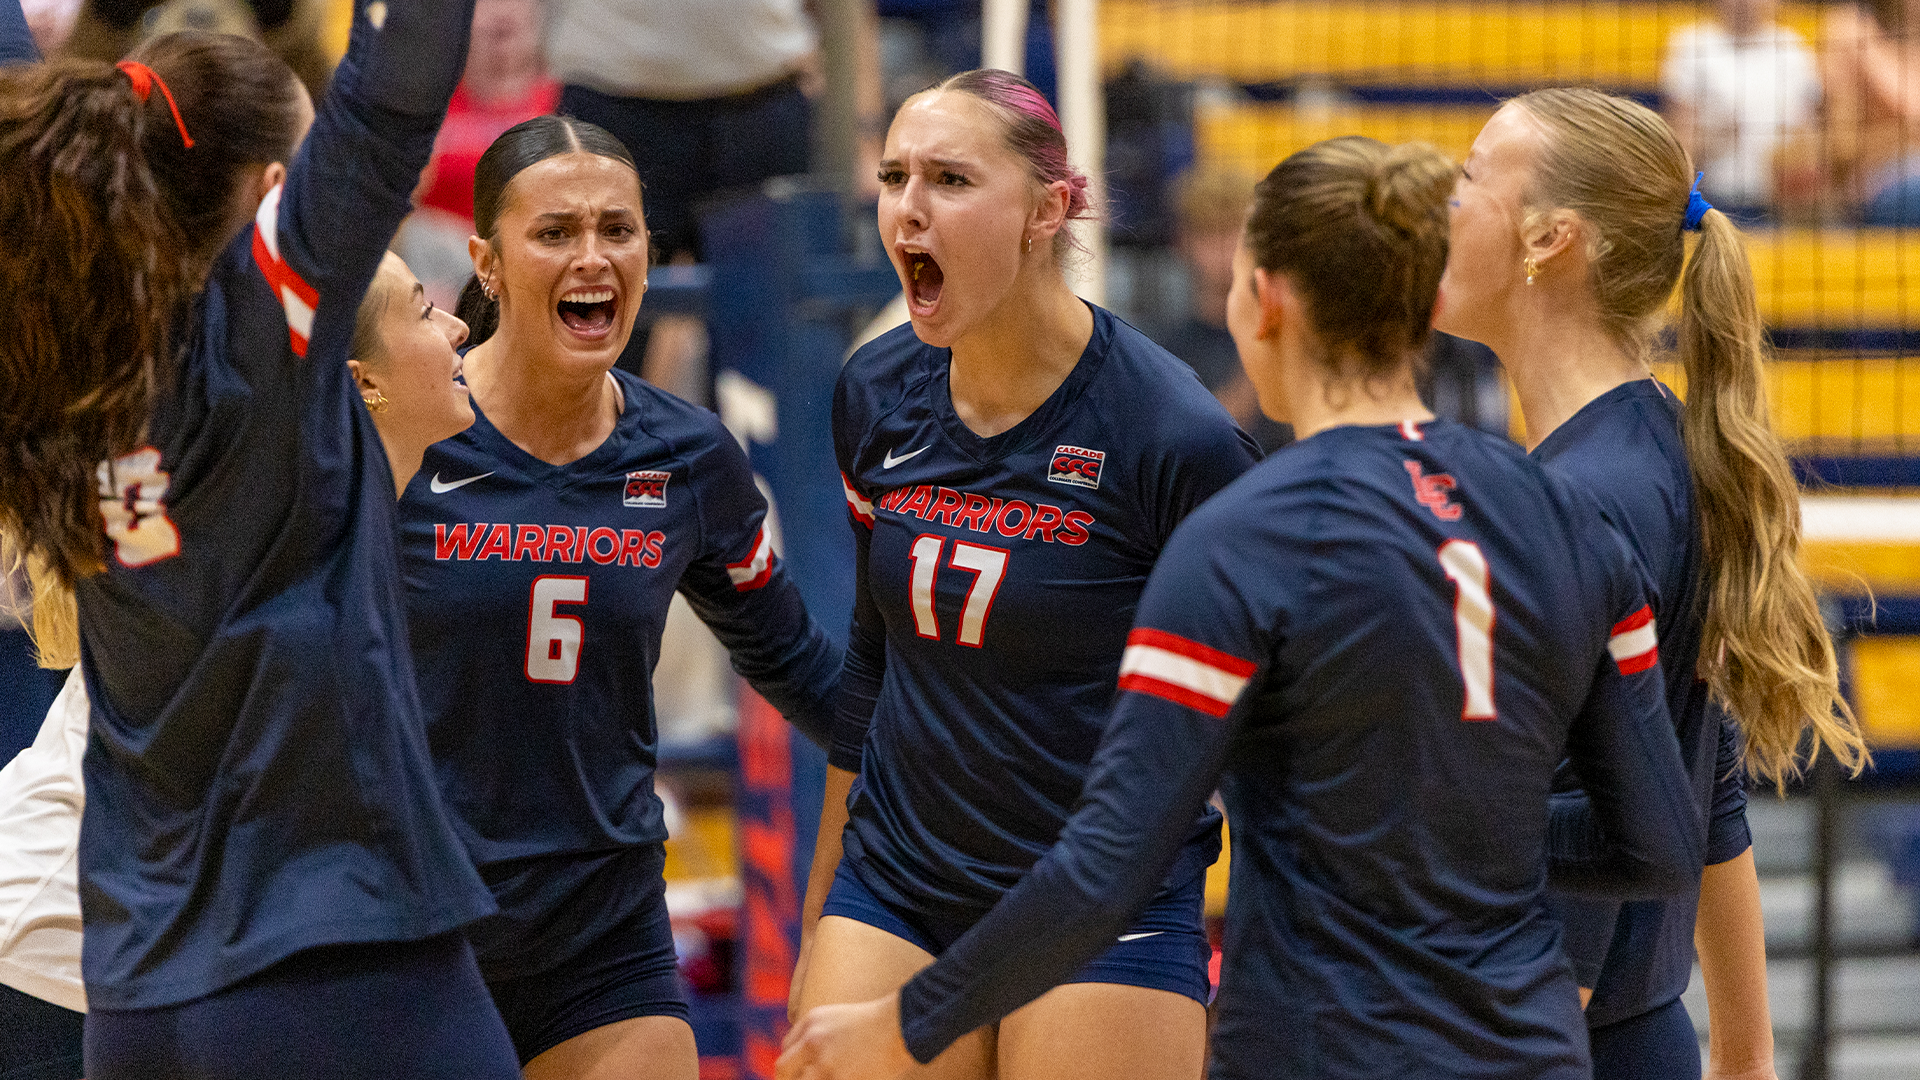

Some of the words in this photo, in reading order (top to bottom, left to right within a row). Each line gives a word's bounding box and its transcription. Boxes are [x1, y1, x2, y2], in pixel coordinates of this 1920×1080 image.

[1053, 456, 1099, 477] CCC
[1057, 447, 1103, 459] CASCADE
[627, 481, 663, 496] CCC
[879, 485, 1095, 546] WARRIORS
[433, 523, 666, 569] WARRIORS
[908, 533, 1011, 648] 17
[524, 574, 590, 685] 6
[1437, 537, 1498, 721] 1
